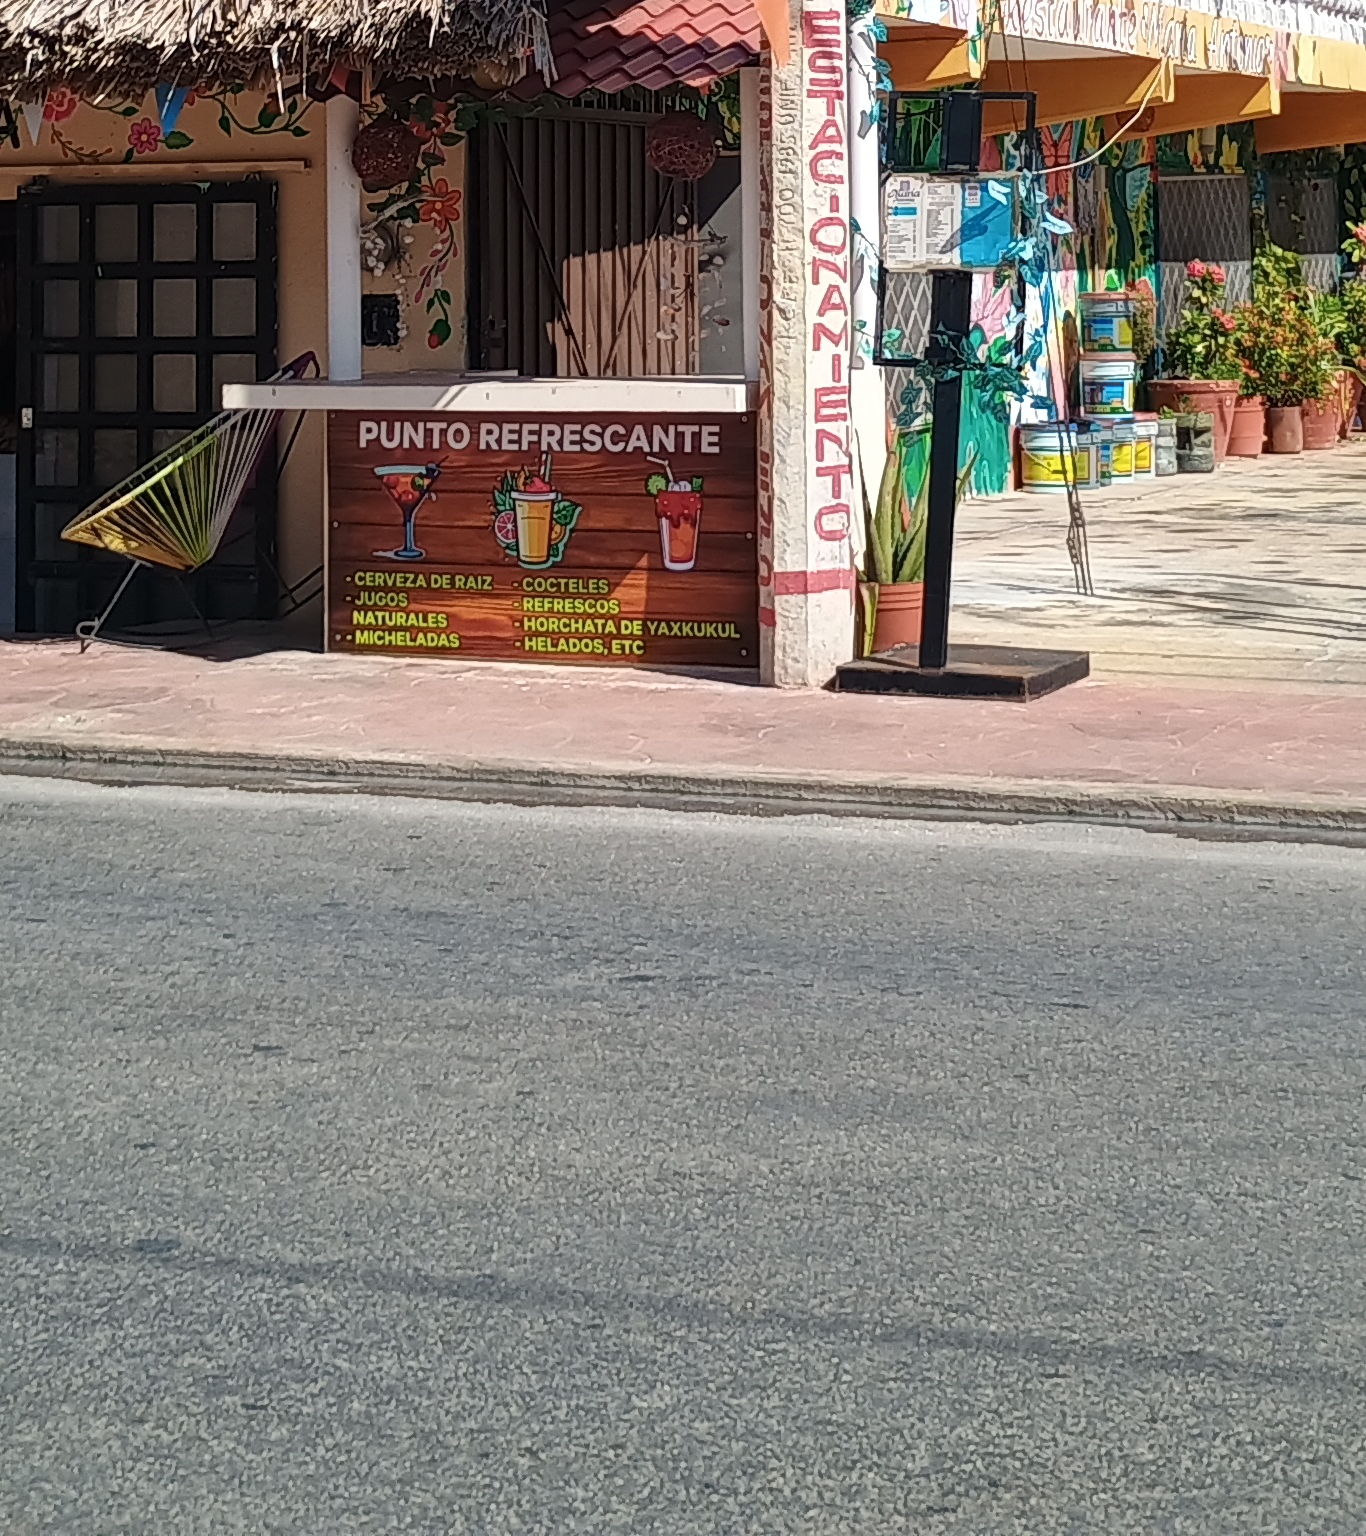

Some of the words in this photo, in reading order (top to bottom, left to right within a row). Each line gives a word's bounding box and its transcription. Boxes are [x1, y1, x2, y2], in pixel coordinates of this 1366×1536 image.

[803, 10, 850, 541] ESTACIONAMIENTO
[359, 420, 472, 451] PUNTO
[478, 422, 721, 455] REFRESCANTE
[354, 571, 427, 590] CERVEZA
[430, 573, 454, 590] DE
[456, 573, 493, 591] RAIZ
[522, 577, 609, 594] COCTELES
[355, 590, 408, 608] JUGOS
[523, 596, 620, 614] REFRESCOS
[352, 610, 448, 628] NATURALES
[523, 616, 617, 635] HORCHATA
[620, 619, 643, 636] DE
[646, 621, 740, 640] YAXKUKUL
[355, 630, 460, 648] MICHELADAS
[524, 636, 608, 656] HELADOS,
[612, 638, 645, 655] ETC
